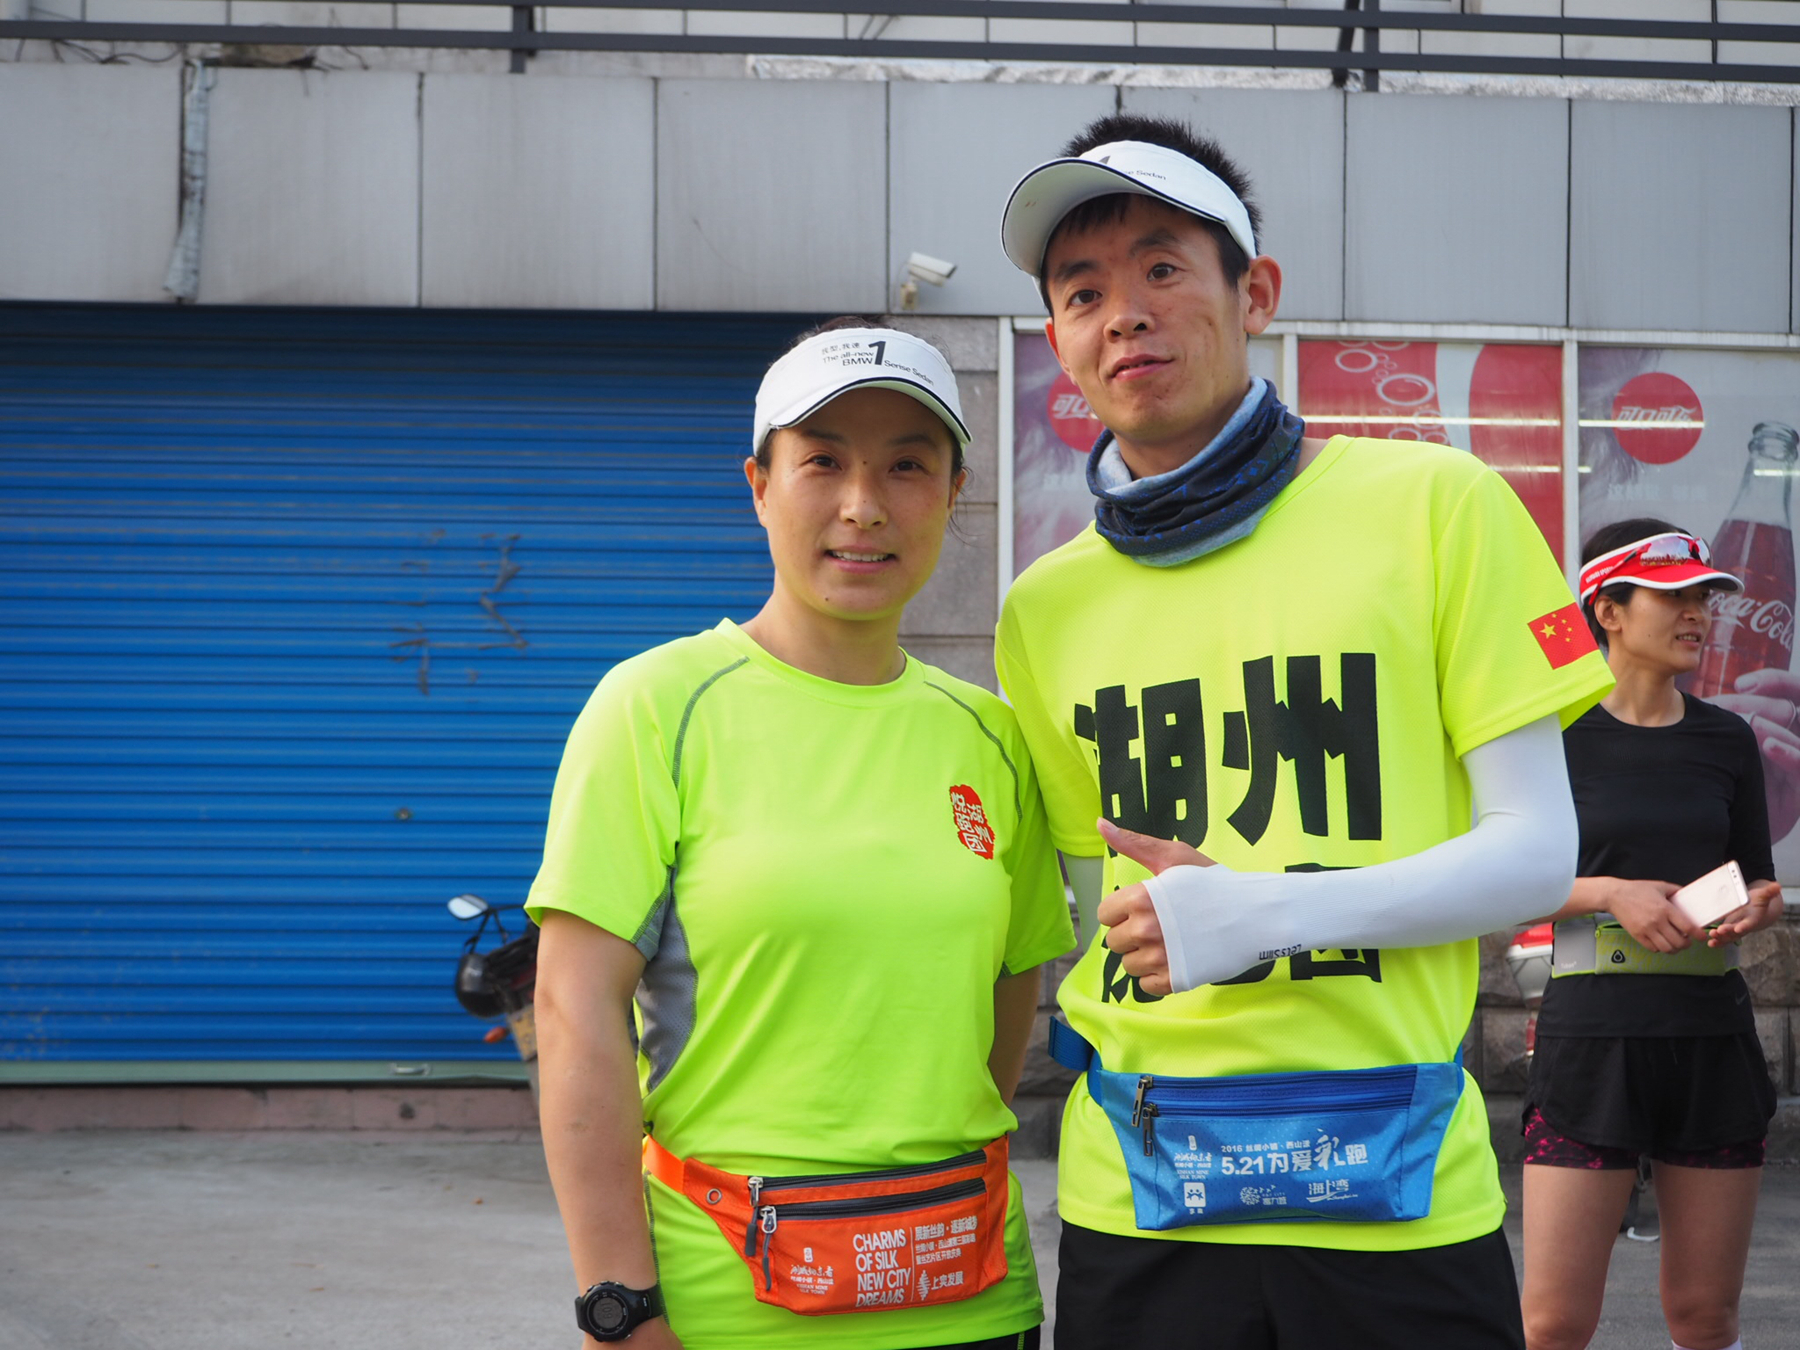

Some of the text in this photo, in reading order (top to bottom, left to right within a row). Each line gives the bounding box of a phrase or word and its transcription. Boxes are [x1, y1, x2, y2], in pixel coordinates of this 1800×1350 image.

[842, 357, 873, 367] BMW
[868, 340, 887, 366] 1
[912, 367, 934, 386] Sedan
[1074, 653, 1382, 858] 湖州
[1221, 1145, 1243, 1153] 2016
[853, 1228, 907, 1253] CHARMS
[855, 1252, 873, 1272] OF
[875, 1250, 899, 1270] SILK
[857, 1271, 885, 1292] NEW
[886, 1267, 912, 1289] CITY
[855, 1288, 905, 1308] DREAMS
